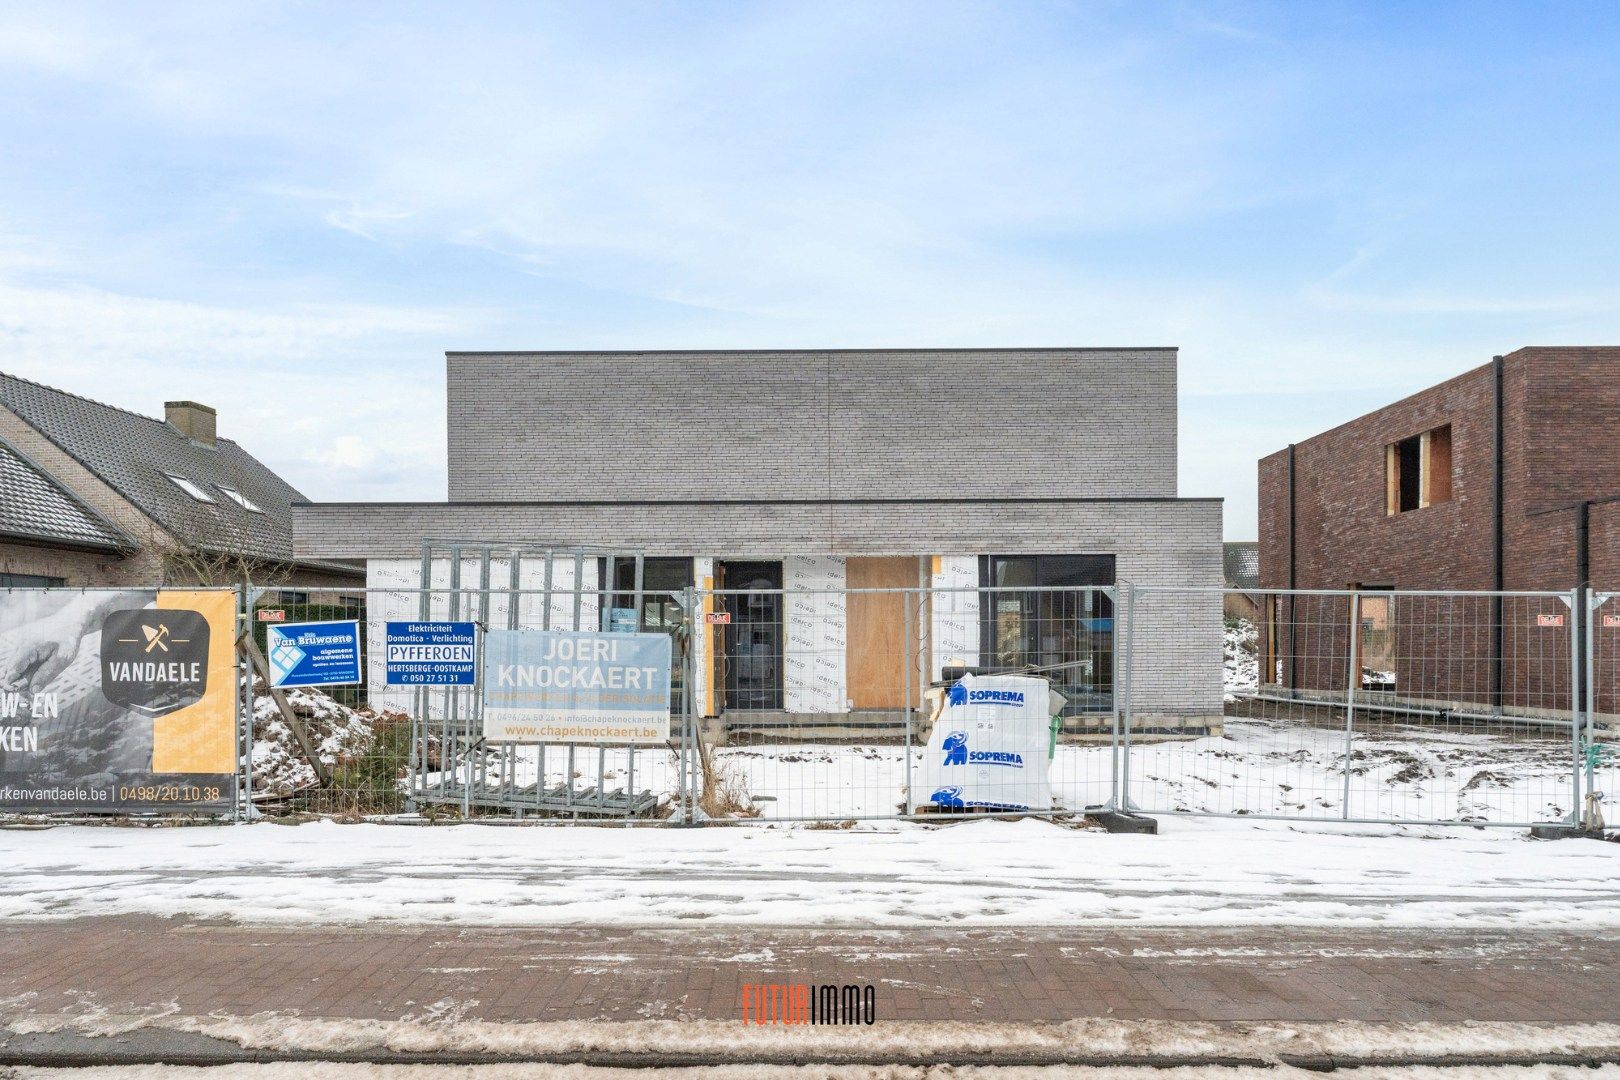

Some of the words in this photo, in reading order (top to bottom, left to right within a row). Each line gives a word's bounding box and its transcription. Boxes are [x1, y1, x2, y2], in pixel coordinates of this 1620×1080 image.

[408, 624, 452, 632] Elektriciteit
[275, 638, 296, 647] Van
[298, 635, 353, 646] Bruwaene
[431, 634, 473, 644] Verlichting
[390, 646, 471, 660] PYFFEROEN
[543, 638, 617, 662] JOERI
[110, 662, 200, 682] VANDAELE
[388, 664, 473, 672] HERTSBERGE-OOSTKAMP
[498, 664, 657, 690] KNOCKAERT
[970, 690, 1024, 702] SOPREMA
[32, 692, 58, 718] EN
[564, 714, 666, 725] info@chapeknockaert.be
[505, 726, 658, 738] www.chapeknockaert.be
[969, 750, 1023, 764] SOPREMA
[120, 786, 220, 800] 0498/20.10.38
